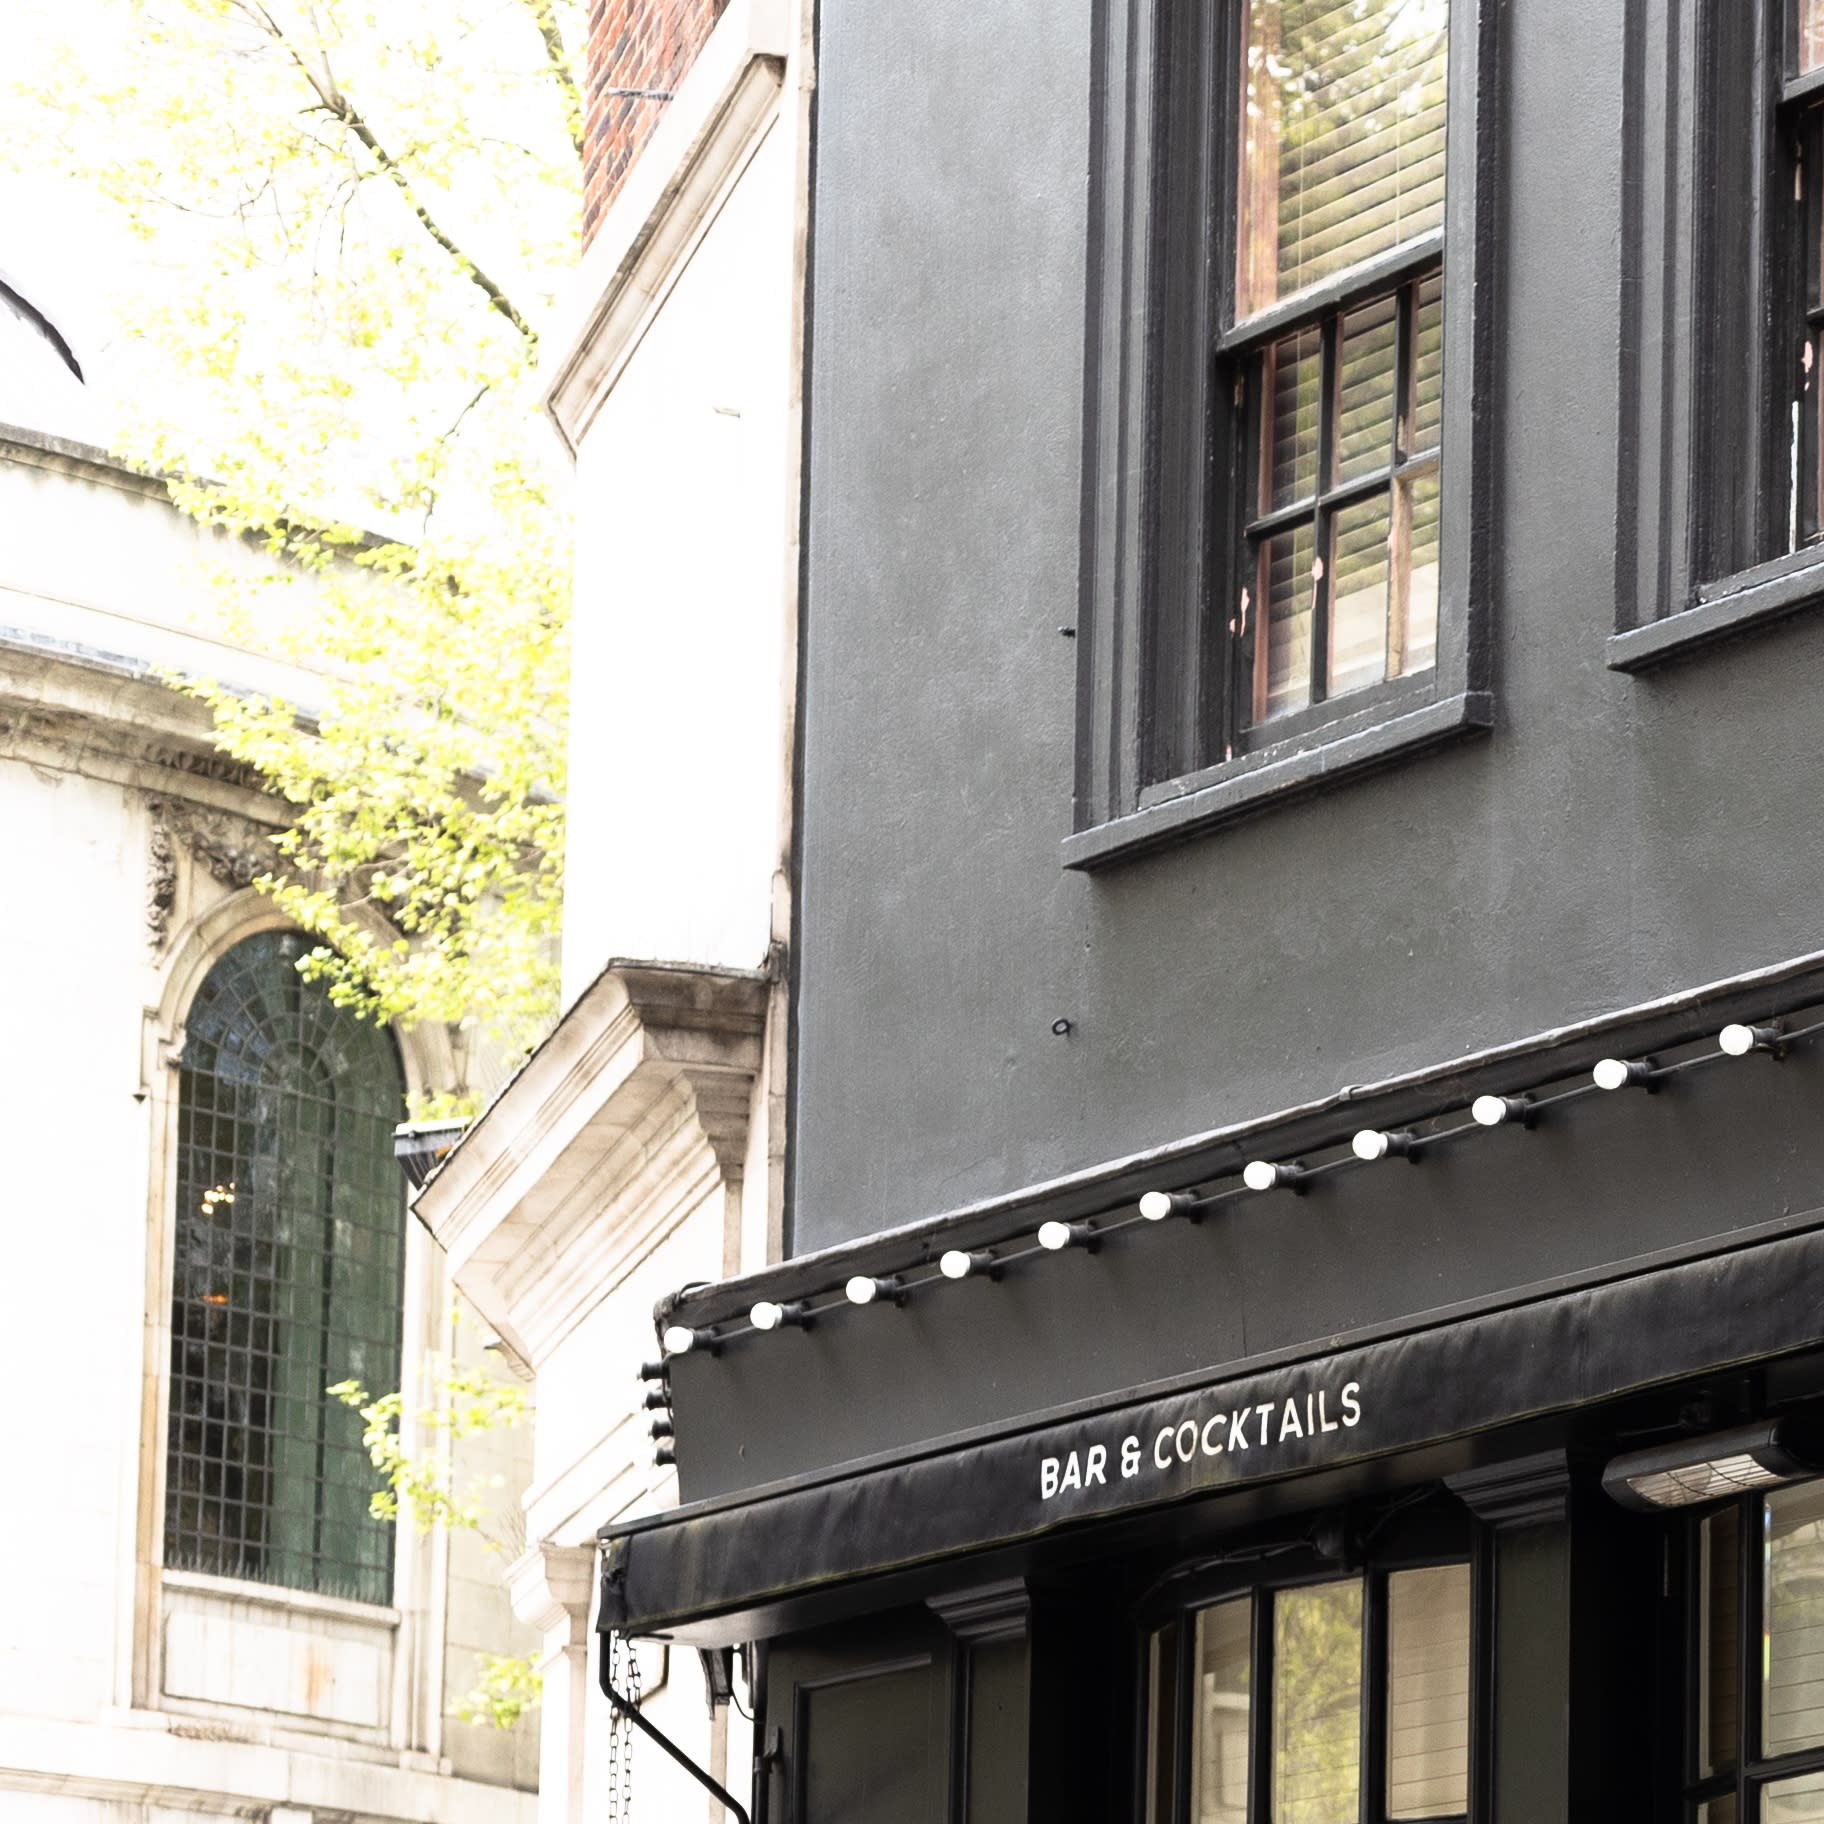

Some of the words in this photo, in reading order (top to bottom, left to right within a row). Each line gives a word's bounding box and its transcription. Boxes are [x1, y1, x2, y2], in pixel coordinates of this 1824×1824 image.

[1041, 1444, 1107, 1499] BAR
[1121, 1435, 1141, 1479] &
[1153, 1381, 1360, 1470] COCKTAILS
